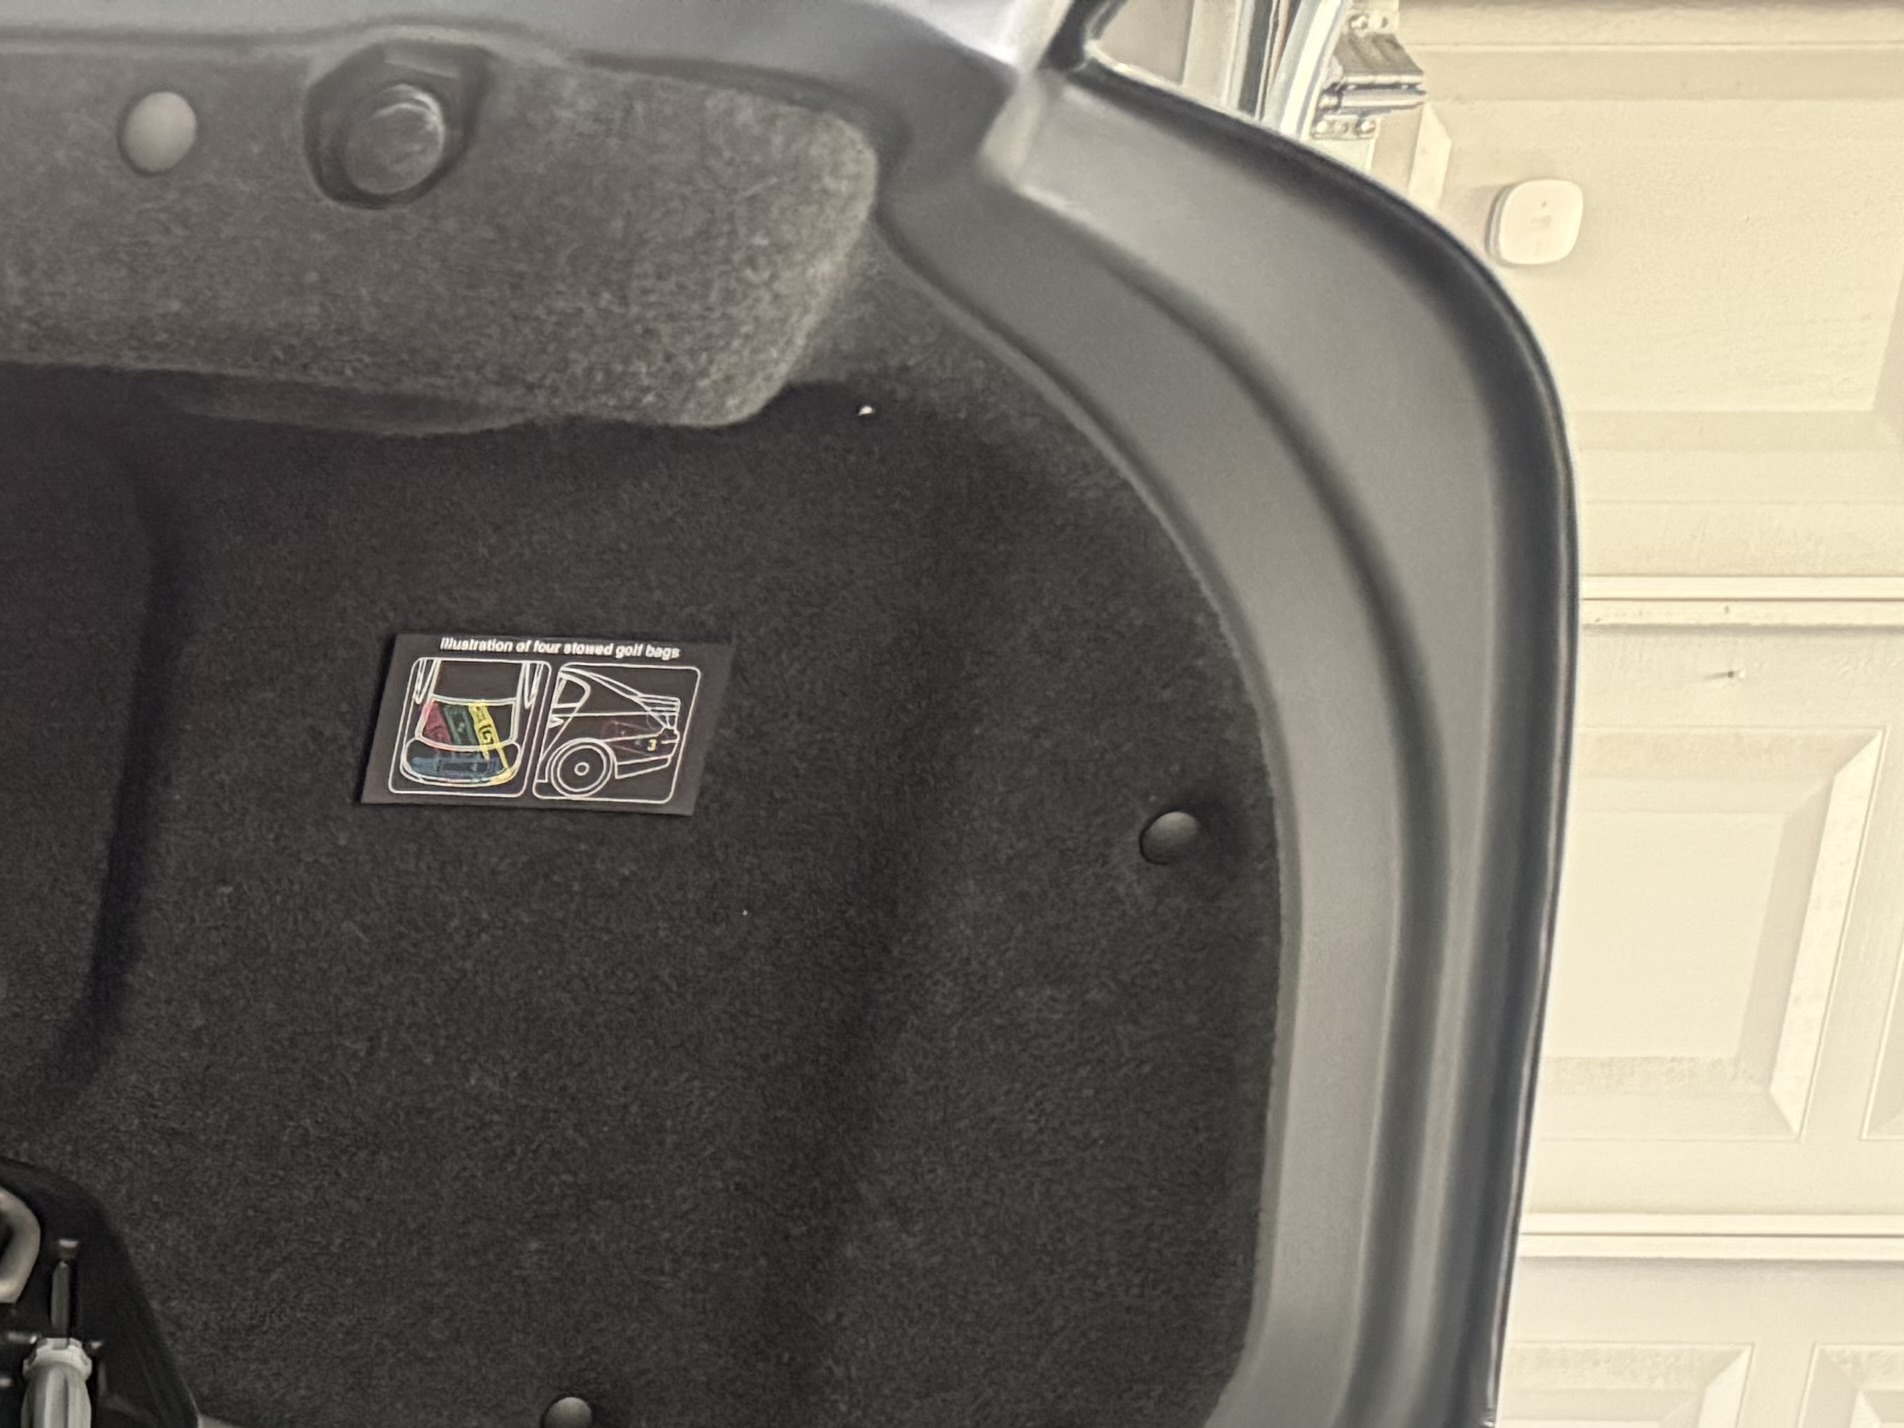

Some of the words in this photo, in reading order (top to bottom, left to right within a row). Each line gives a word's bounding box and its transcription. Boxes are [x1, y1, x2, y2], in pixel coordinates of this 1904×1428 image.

[439, 636, 513, 652] Illustration
[515, 639, 532, 653] of
[533, 640, 562, 654] four
[563, 642, 613, 657] stowed
[615, 644, 643, 659] golf
[645, 644, 681, 661] bags
